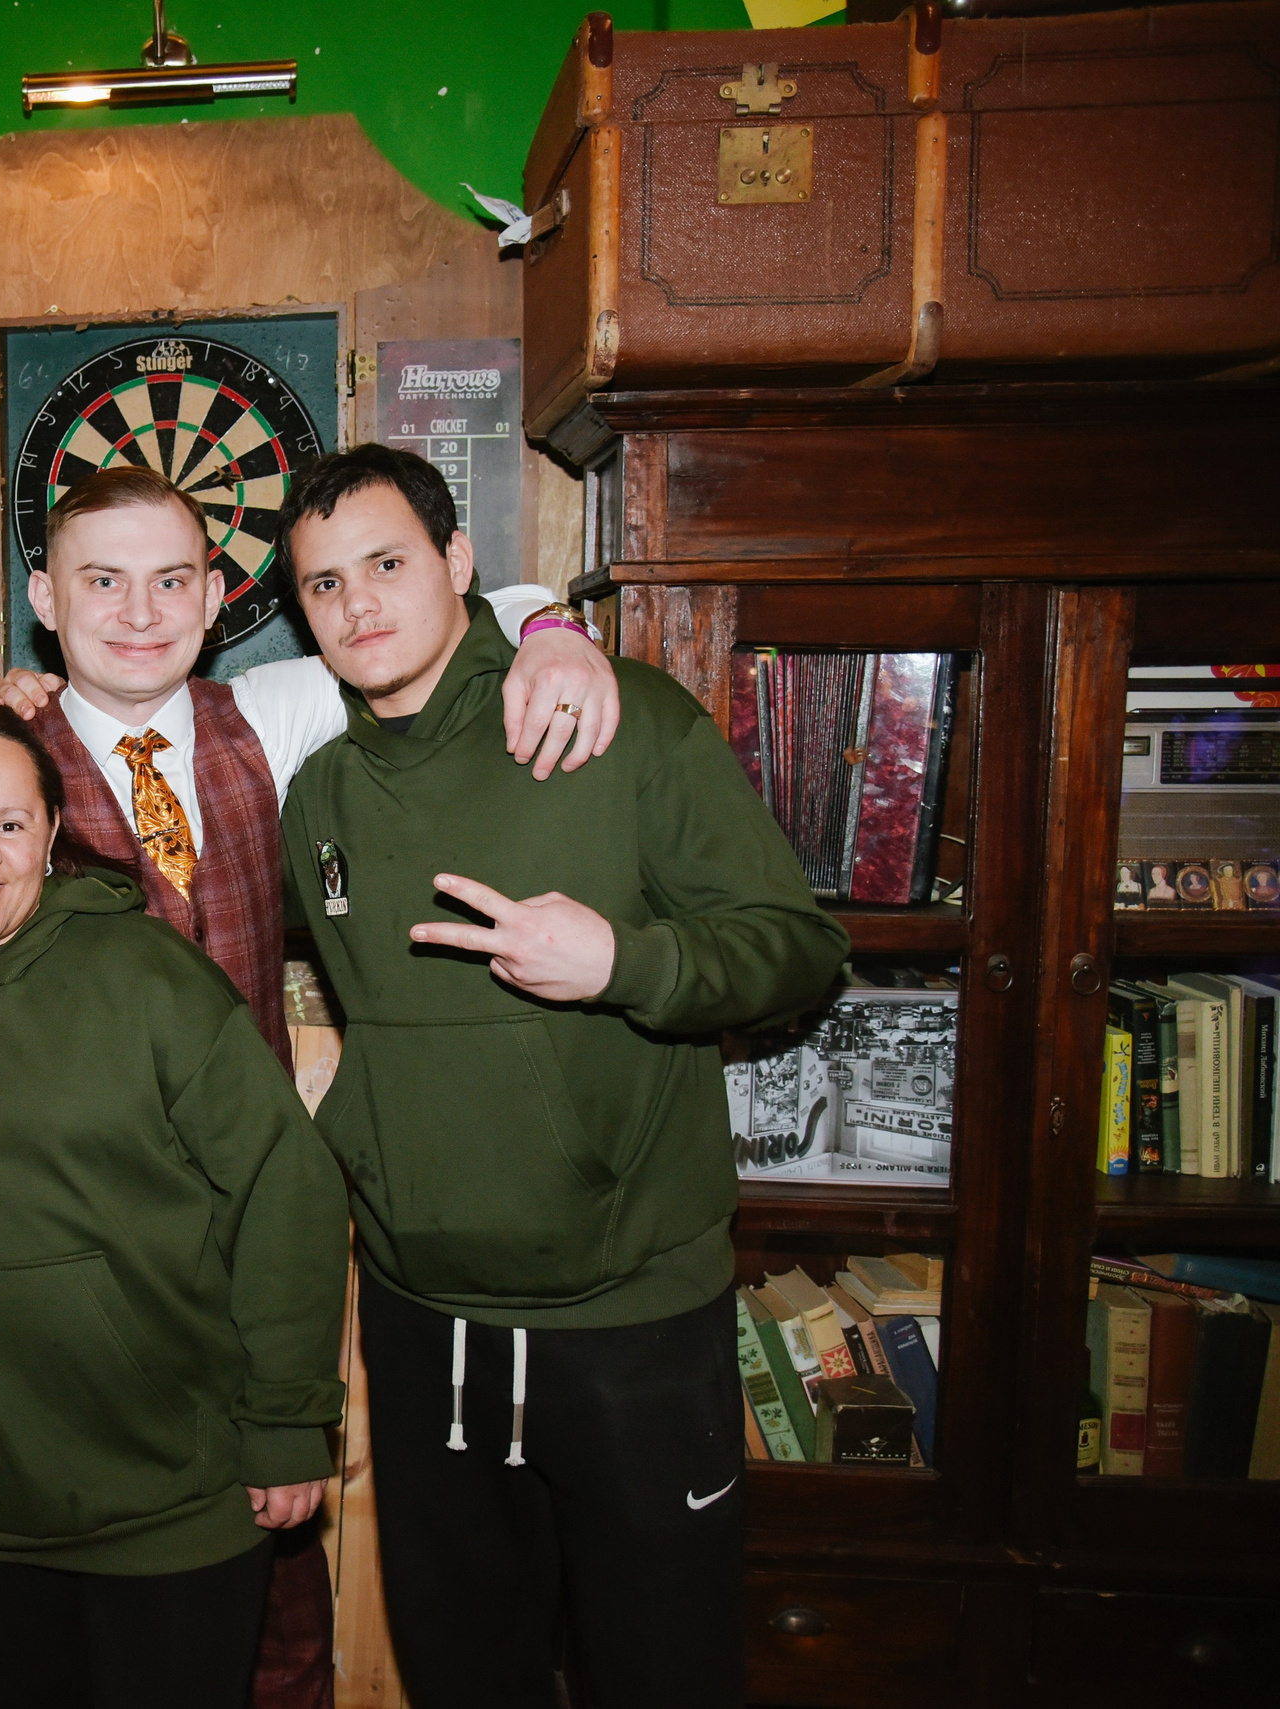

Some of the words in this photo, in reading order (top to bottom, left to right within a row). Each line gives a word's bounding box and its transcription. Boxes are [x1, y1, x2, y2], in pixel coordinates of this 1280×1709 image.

[135, 353, 194, 372] Stinger
[66, 371, 91, 394] 12
[398, 365, 501, 393] Harrows
[401, 424, 415, 434] 01
[430, 419, 468, 434] CRICKET
[495, 422, 510, 433] 01
[440, 442, 458, 454] 20
[440, 464, 458, 476] 19
[448, 485, 458, 497] 8
[1212, 1031, 1221, 1094] ШЕЛКОВИЦЫ
[1212, 1095, 1220, 1120] ТЕНИ
[875, 1164, 911, 1172] MILANO
